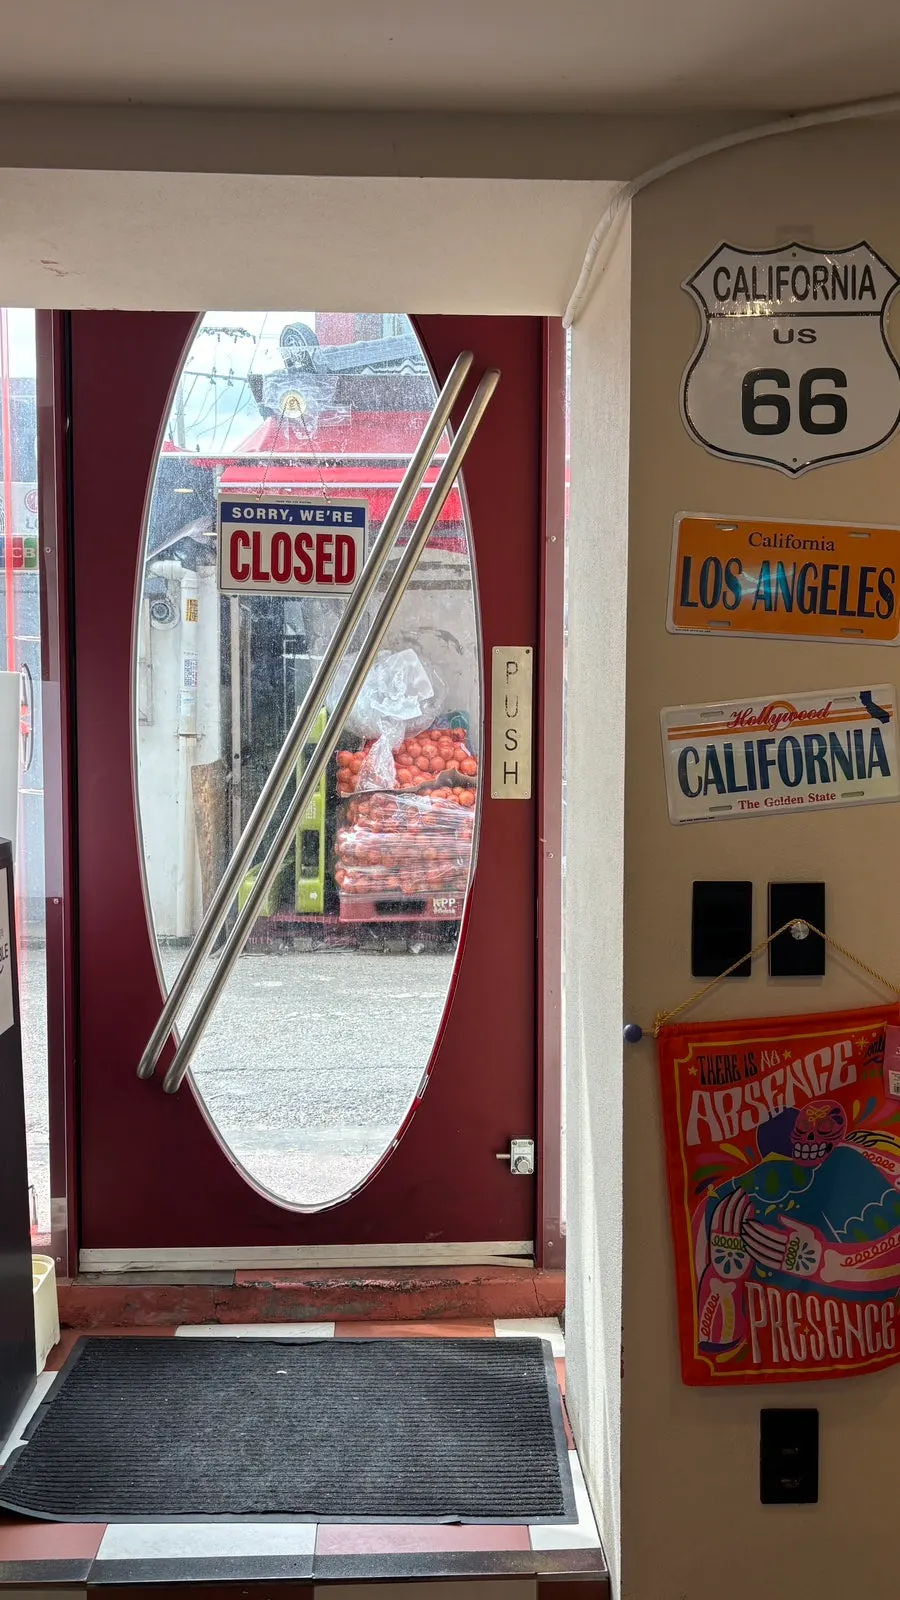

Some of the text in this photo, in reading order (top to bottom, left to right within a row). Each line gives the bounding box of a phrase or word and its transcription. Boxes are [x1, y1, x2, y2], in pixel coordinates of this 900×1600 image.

[713, 264, 877, 301] CALIFORNIA
[773, 328, 817, 344] US
[741, 367, 848, 435] 66
[232, 507, 353, 523] SORRY, WE'RE
[229, 529, 356, 585] CLOSED
[748, 532, 835, 551] California
[680, 555, 896, 620] LOS ANGELES
[503, 661, 519, 785] PUSH
[727, 701, 833, 732] Hollywood
[677, 727, 891, 798] CALIFORNIA
[738, 792, 836, 810] The Golden State
[697, 1054, 742, 1086] THERE
[743, 1051, 758, 1078] IS
[686, 1040, 857, 1146] ABSENCE
[745, 1281, 896, 1364] PRESENCE
